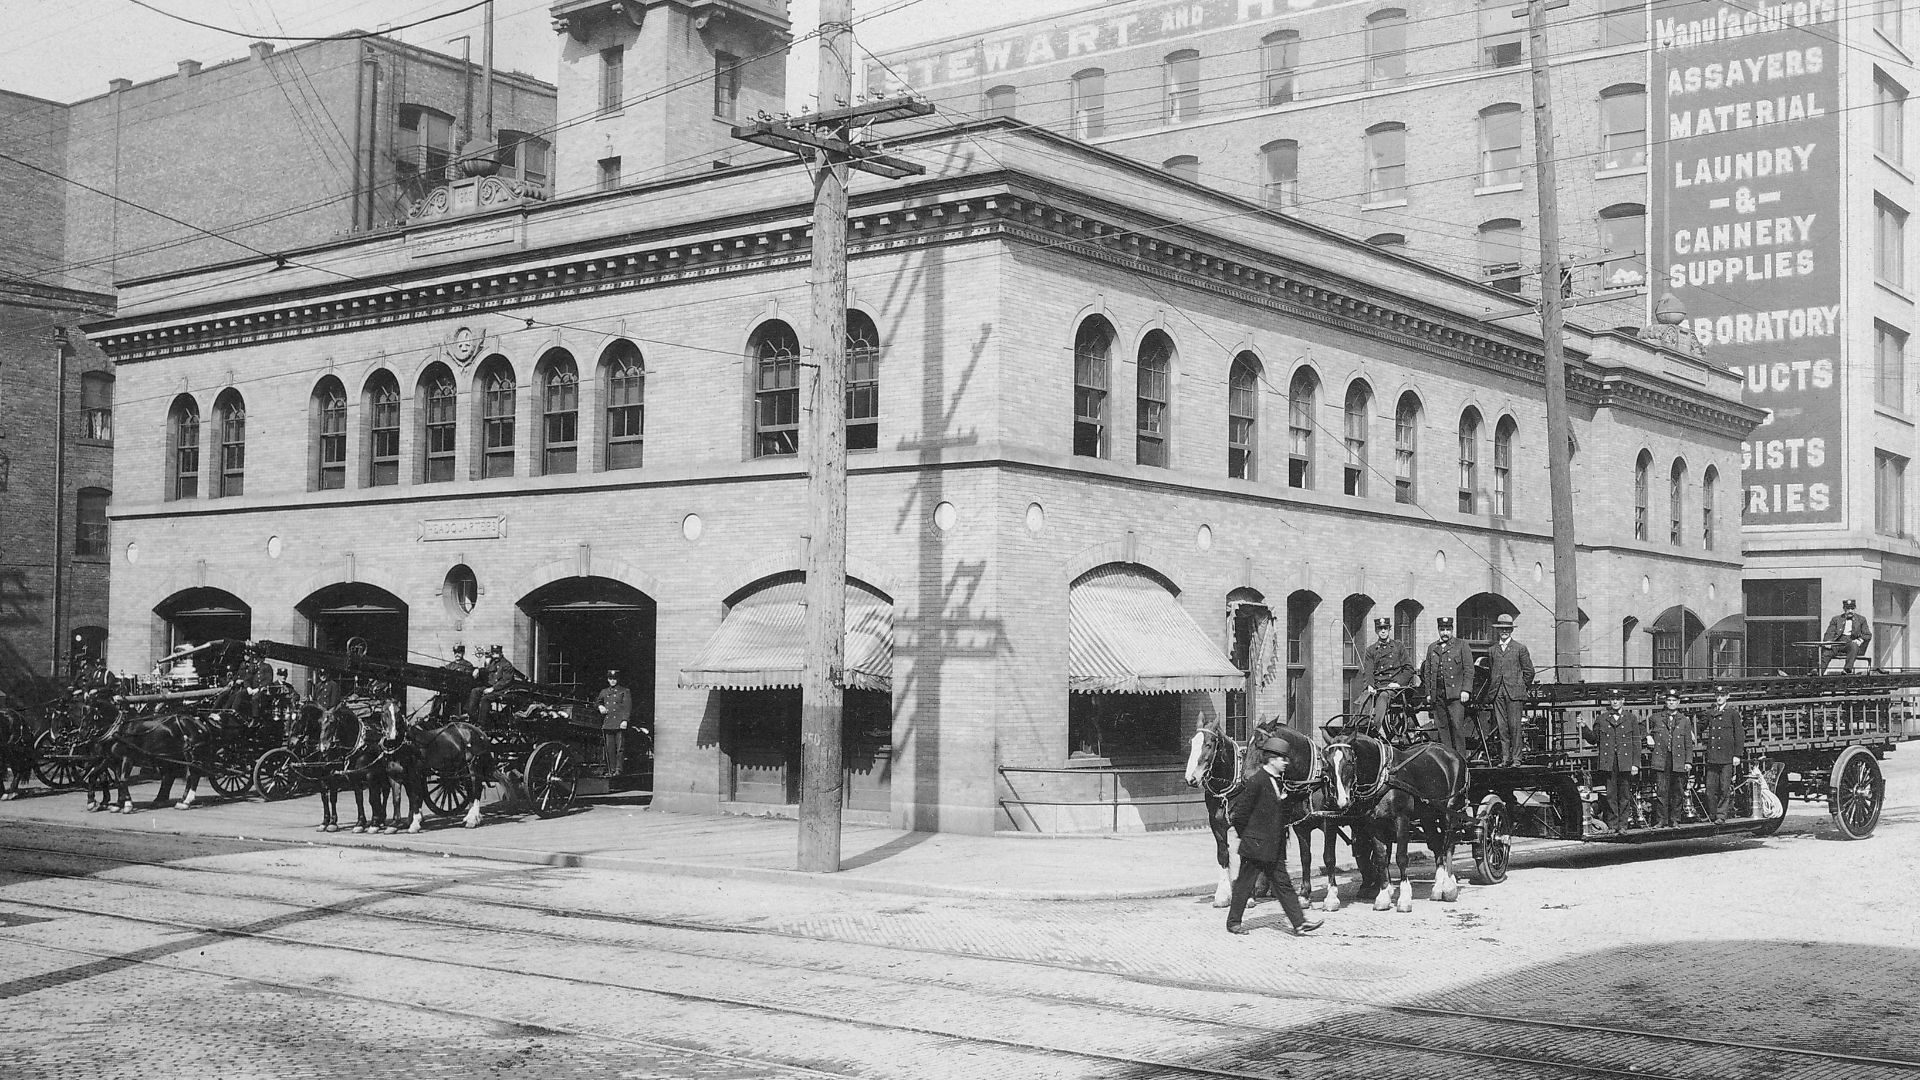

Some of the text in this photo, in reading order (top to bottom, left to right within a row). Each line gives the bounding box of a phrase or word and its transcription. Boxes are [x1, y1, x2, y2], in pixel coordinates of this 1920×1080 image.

[885, 14, 1138, 92] STEWART
[1161, 5, 1204, 32] AND
[1655, 0, 1837, 52] Manufacturers
[1668, 46, 1824, 97] ASSAYERS
[1669, 92, 1825, 140] MATERIAL
[1675, 143, 1817, 188] LAUNDRY
[1675, 214, 1817, 255] CANNERY
[1670, 249, 1814, 288] SUPPLIES
[1679, 304, 1841, 346] BORATORY
[1741, 482, 1830, 513] RIES
